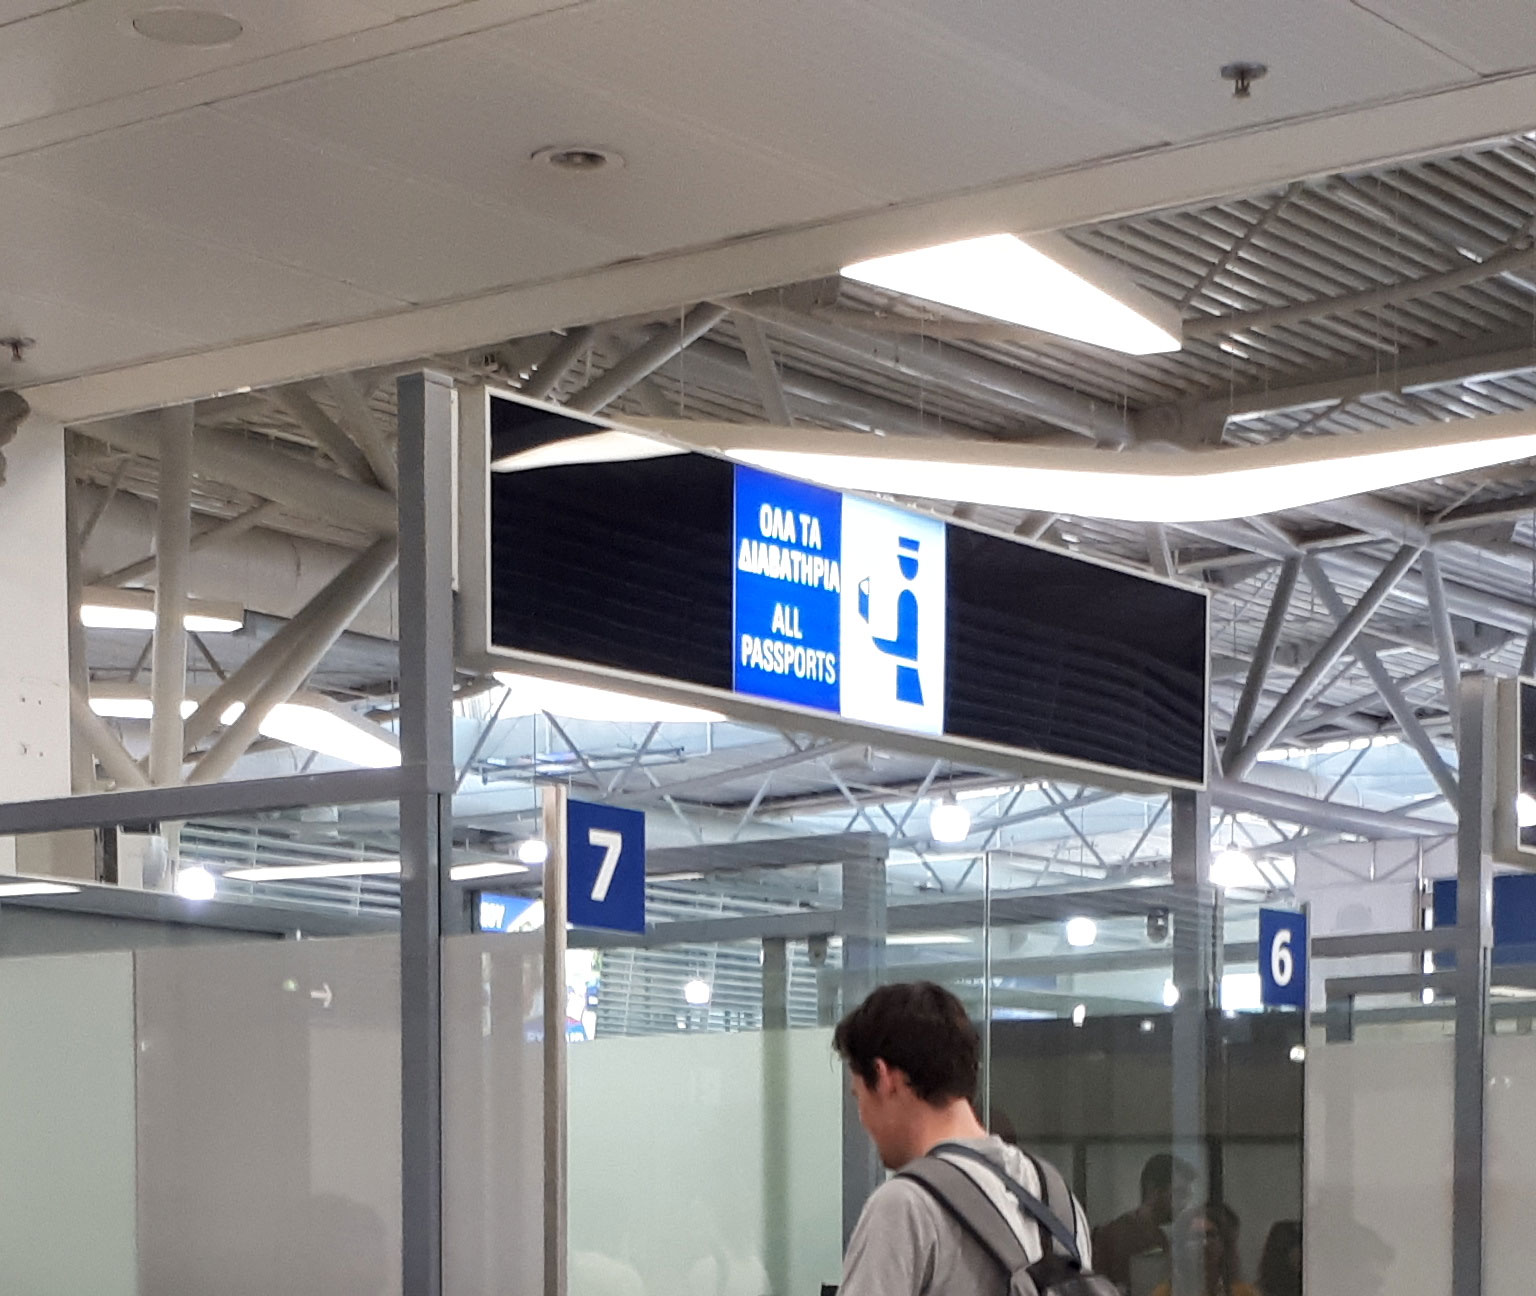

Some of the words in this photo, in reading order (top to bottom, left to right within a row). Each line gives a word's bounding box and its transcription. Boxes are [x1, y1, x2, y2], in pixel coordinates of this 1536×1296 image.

[759, 503, 797, 544] ΟΛΑ
[799, 513, 822, 550] ΤΑ
[737, 537, 841, 593] ΔΙΑΒΑΤΗΡΙΑ
[771, 602, 803, 639] ALL
[740, 633, 837, 685] PASSPORTS
[587, 828, 623, 903] 7
[1270, 928, 1293, 987] 6
